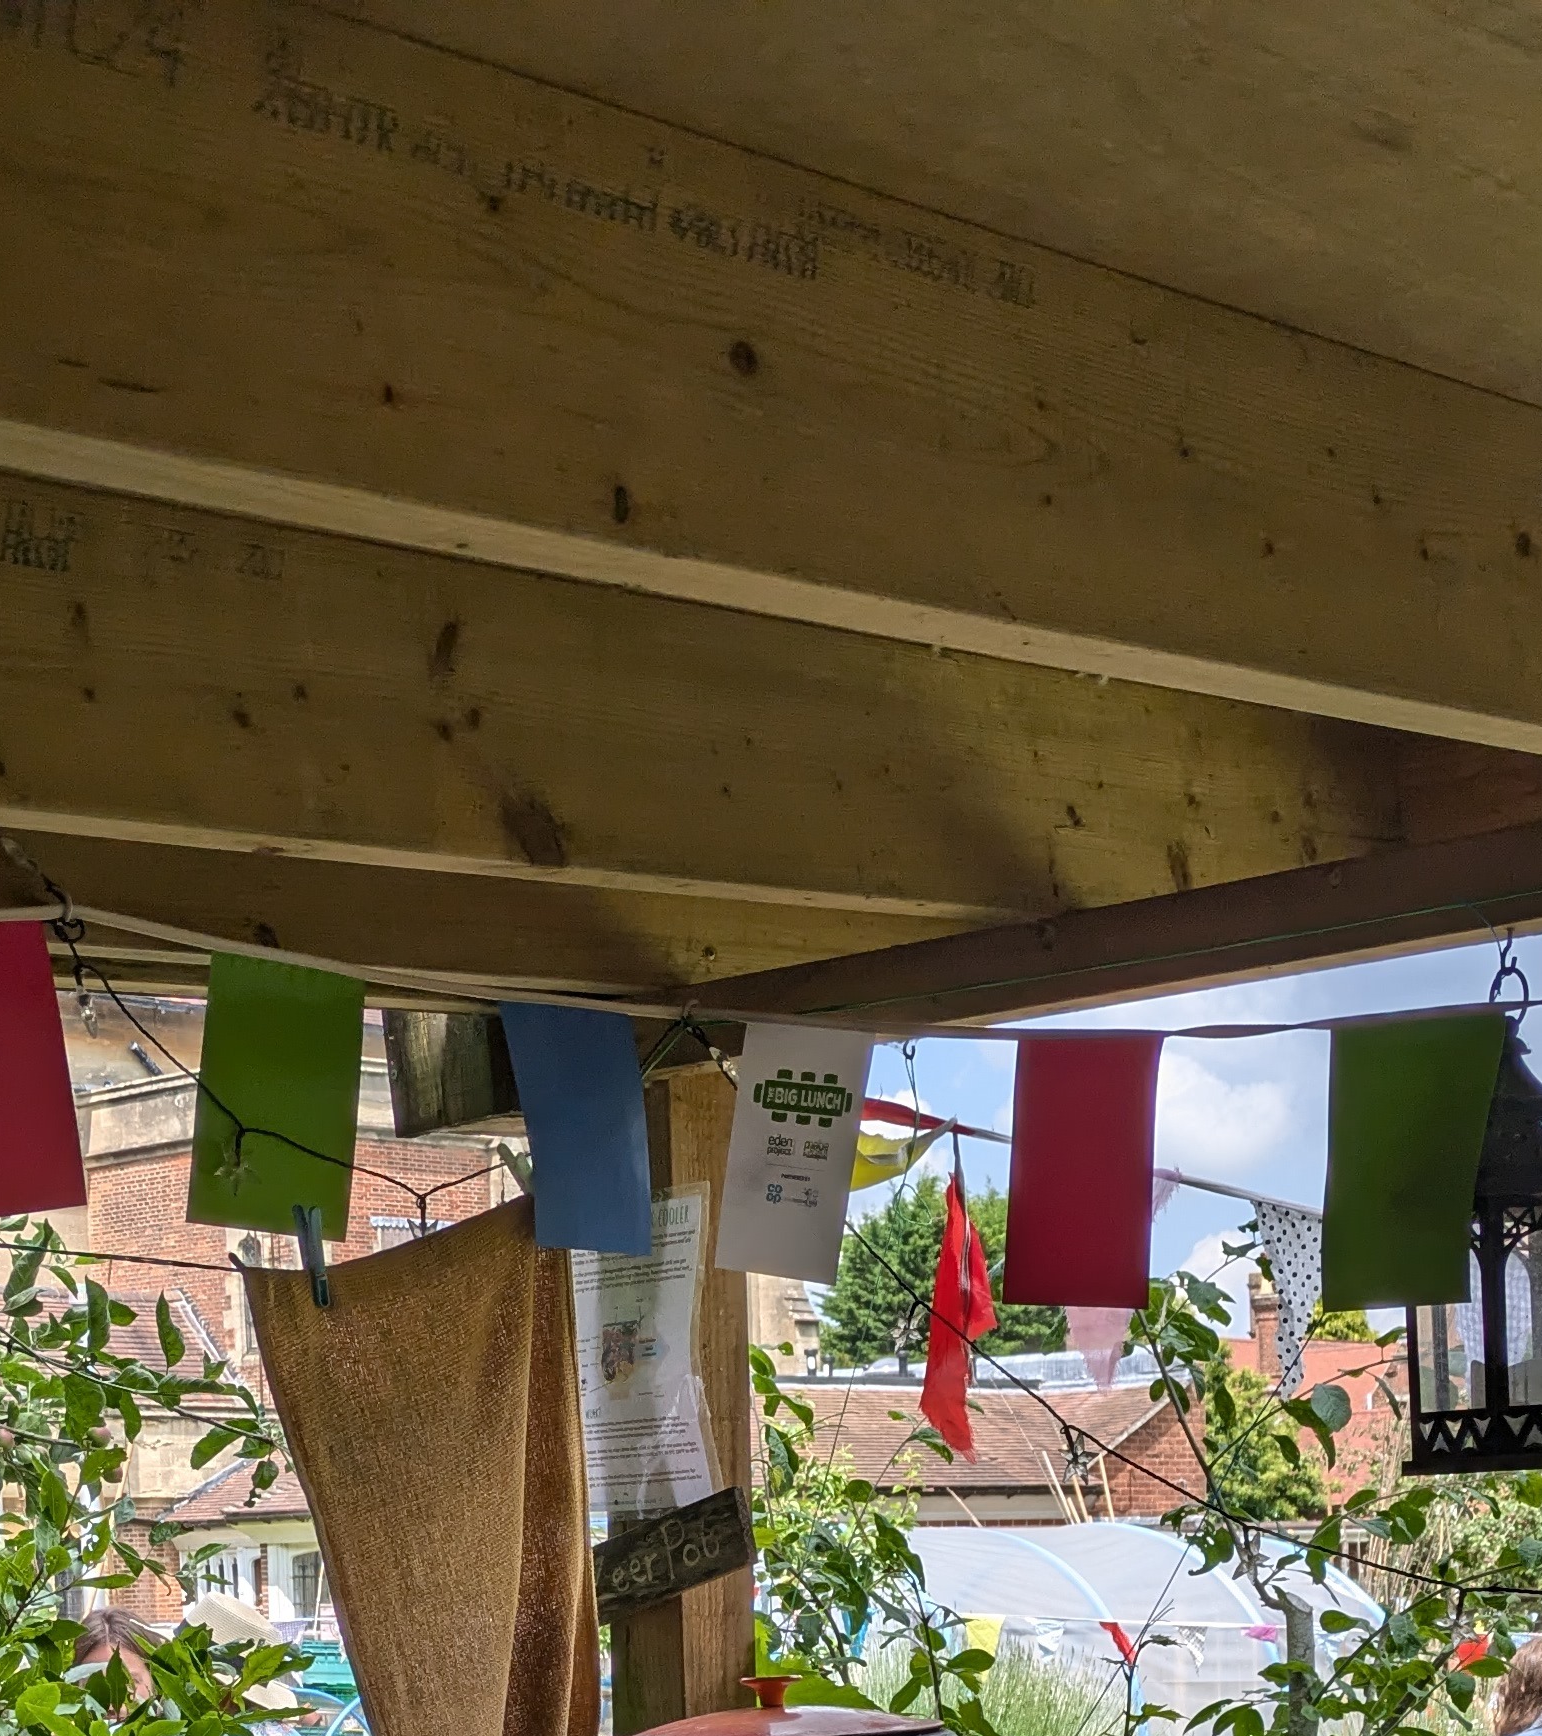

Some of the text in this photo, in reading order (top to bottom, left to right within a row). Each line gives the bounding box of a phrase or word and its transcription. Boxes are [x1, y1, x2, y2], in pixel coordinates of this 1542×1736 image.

[775, 1087, 798, 1106] BIG
[800, 1089, 843, 1111] LUNCH
[768, 1134, 794, 1147] eden
